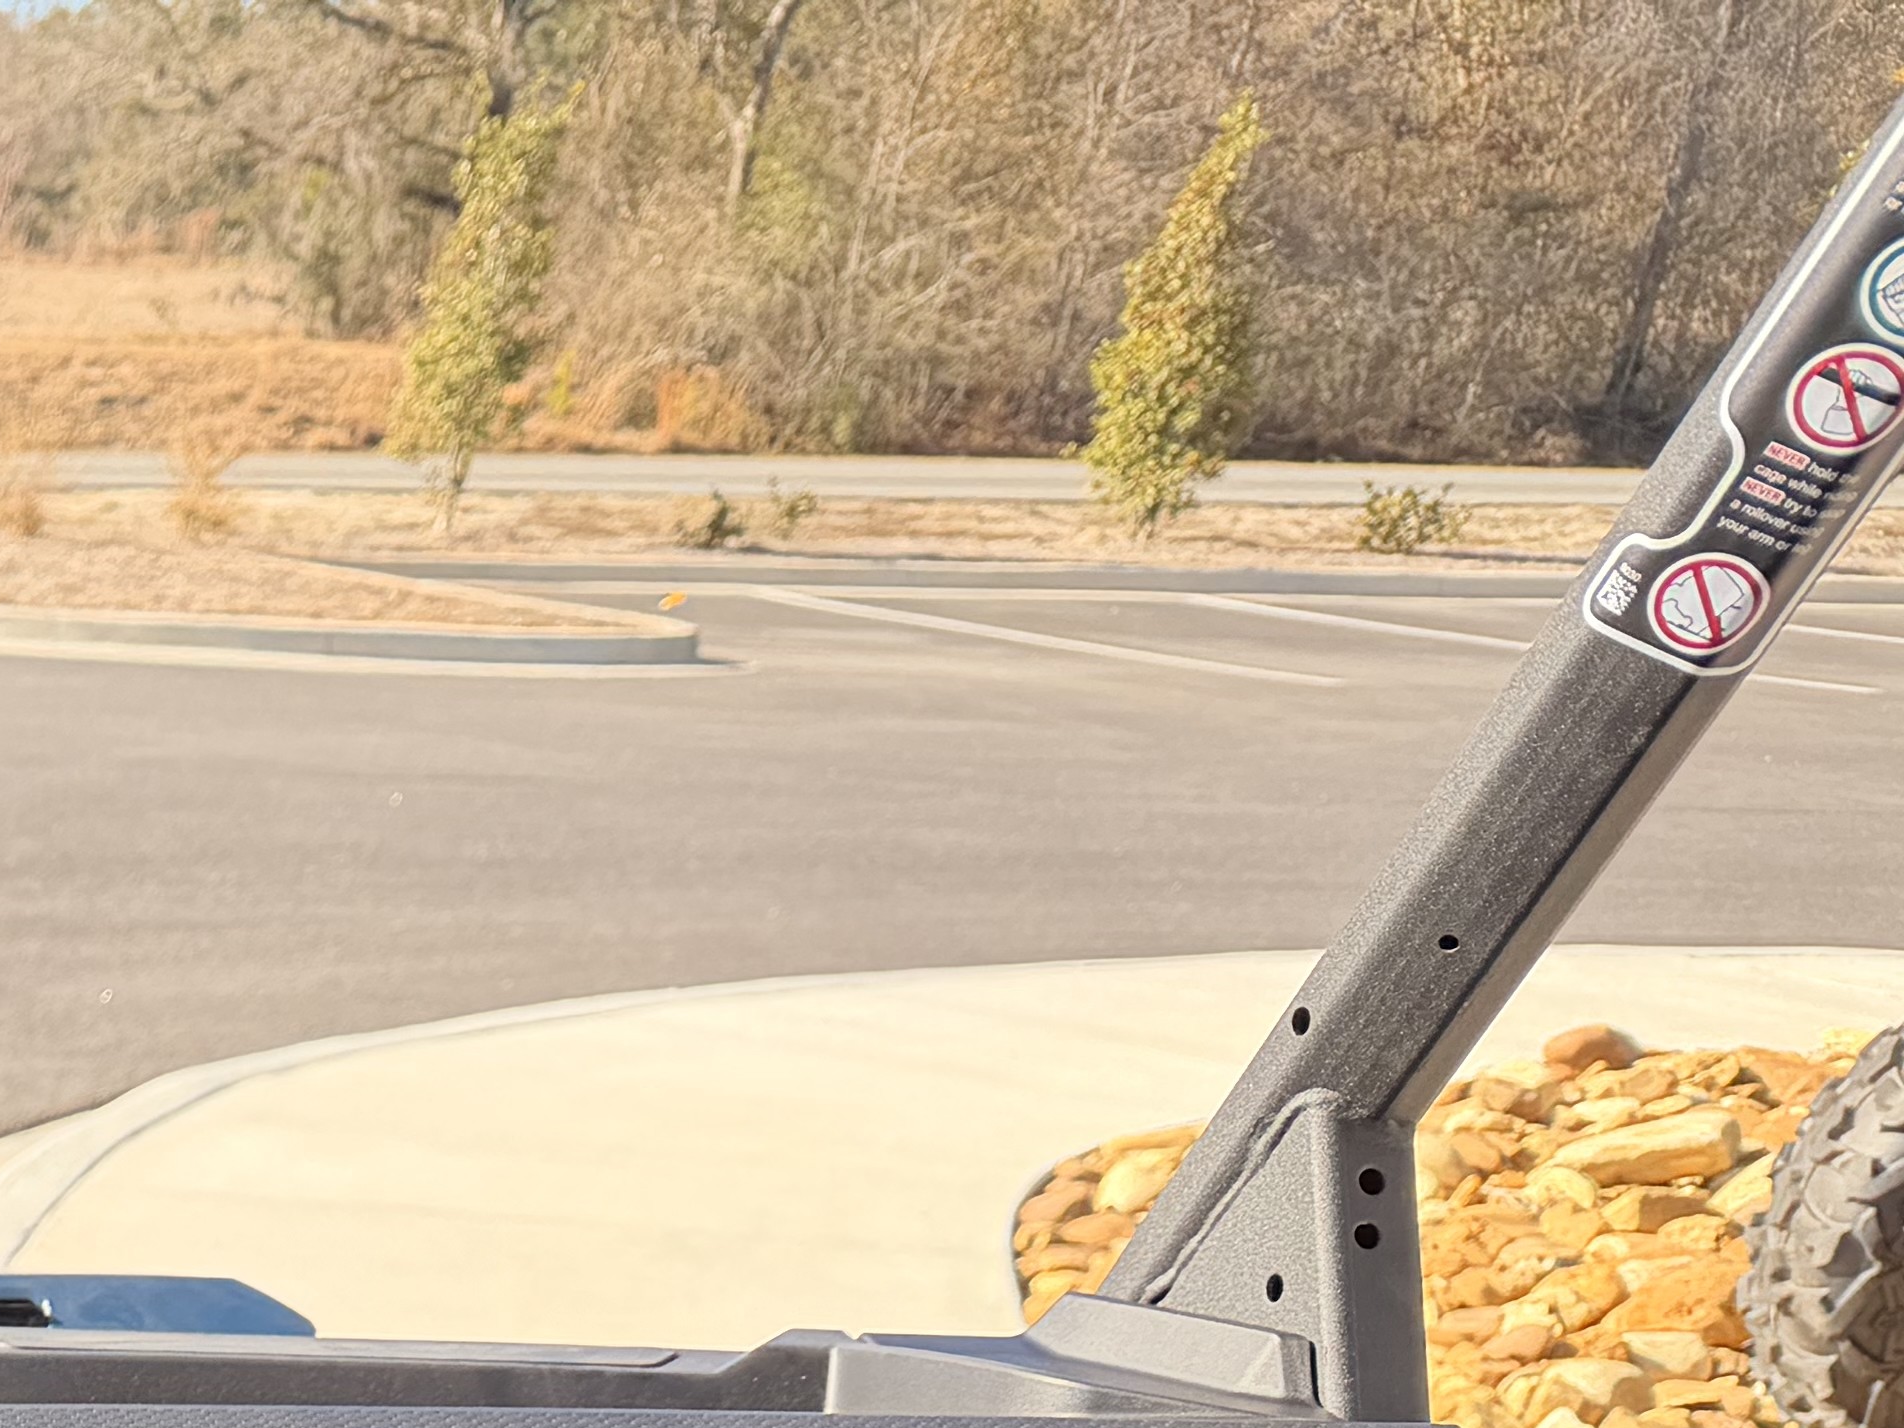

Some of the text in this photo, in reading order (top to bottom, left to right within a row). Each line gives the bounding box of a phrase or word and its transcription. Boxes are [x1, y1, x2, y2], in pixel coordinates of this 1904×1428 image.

[1765, 442, 1810, 470] NEVER
[1807, 462, 1839, 482] hold
[1742, 477, 1786, 505] NEVER
[1783, 498, 1803, 514] try
[1803, 505, 1818, 518] to
[1787, 478, 1823, 499] while
[1717, 516, 1750, 535] your
[1748, 528, 1775, 547] arm
[1741, 504, 1792, 531] rollover
